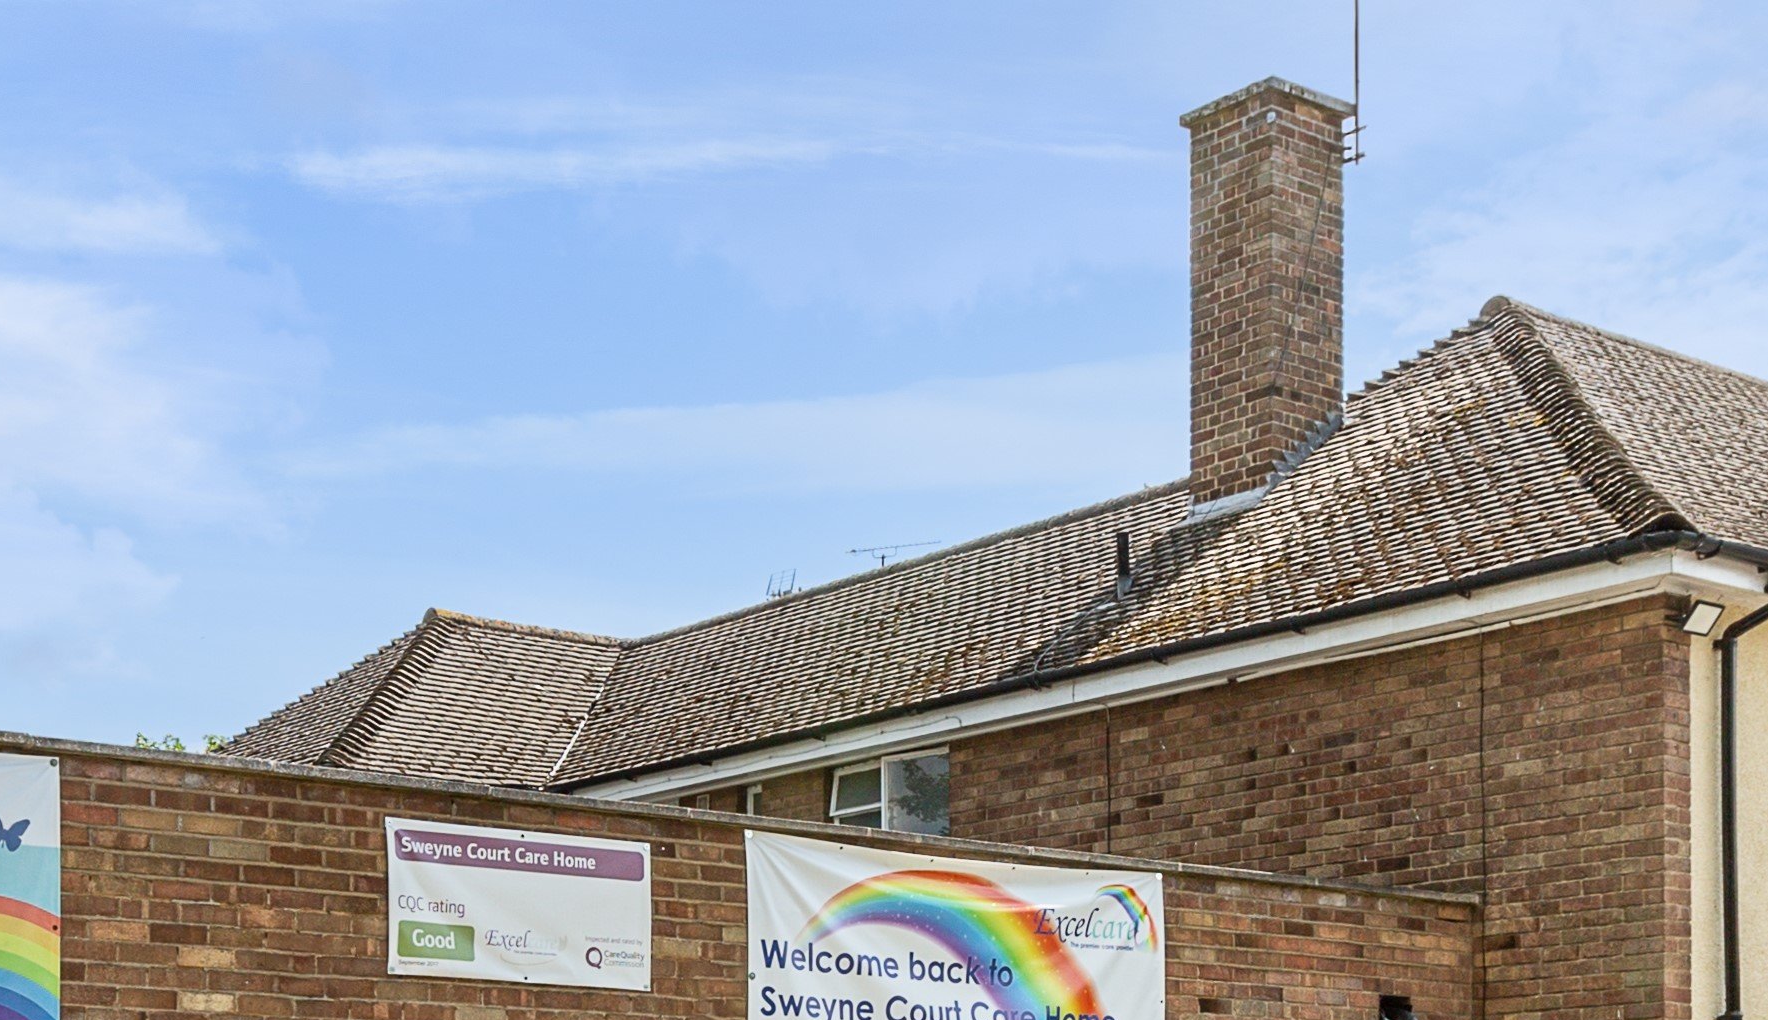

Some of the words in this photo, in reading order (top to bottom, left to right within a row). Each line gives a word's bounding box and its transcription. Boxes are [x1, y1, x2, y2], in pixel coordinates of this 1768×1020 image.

[401, 837, 462, 859] Sweyne
[466, 842, 511, 862] Court
[515, 848, 549, 866] Care
[553, 851, 596, 870] Home
[397, 894, 424, 913] CQC
[427, 899, 466, 918] rating
[411, 929, 456, 950] Good
[1032, 907, 1138, 943] Excelcare
[761, 939, 899, 979] Welcome
[909, 952, 980, 985] back
[989, 958, 1013, 987] to
